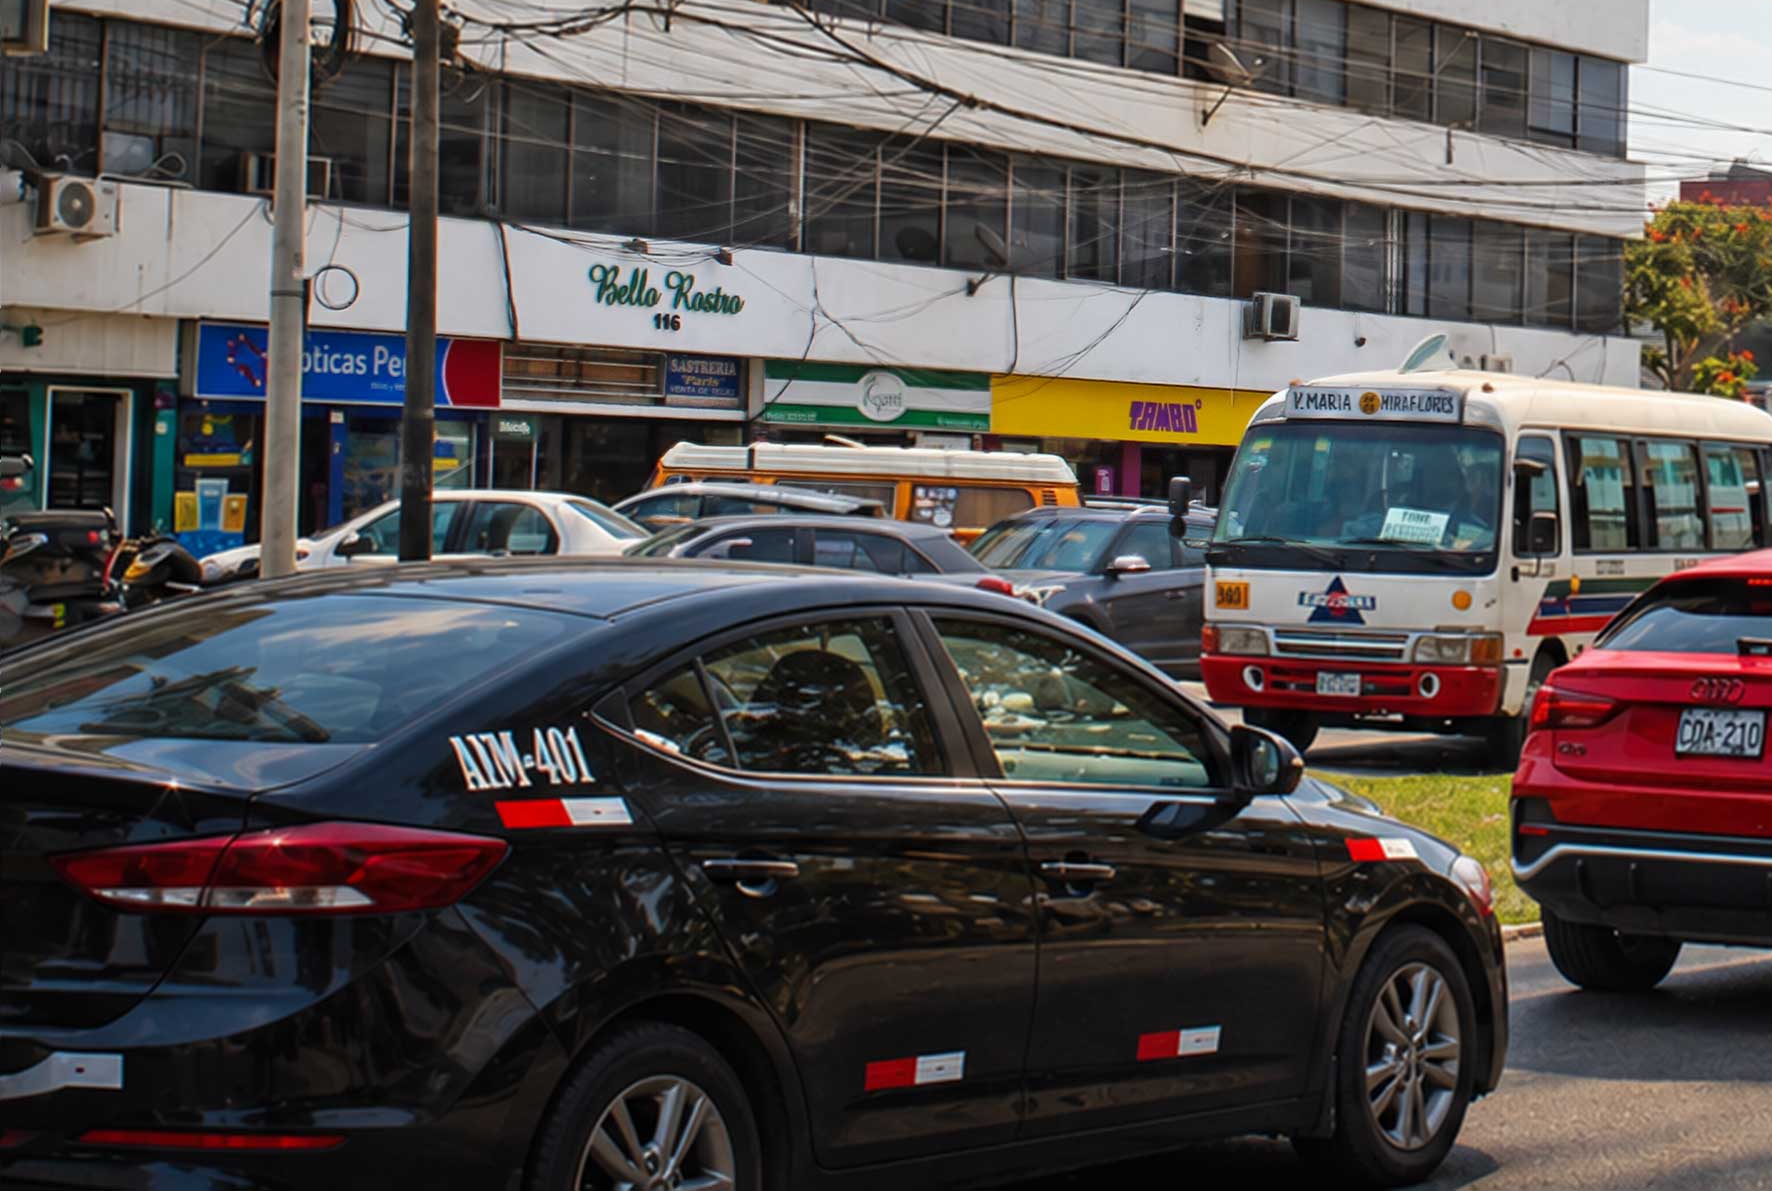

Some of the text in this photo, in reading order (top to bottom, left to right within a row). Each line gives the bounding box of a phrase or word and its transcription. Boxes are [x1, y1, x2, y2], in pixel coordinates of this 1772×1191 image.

[588, 264, 745, 315] Bello Rostro
[653, 312, 682, 331] 116
